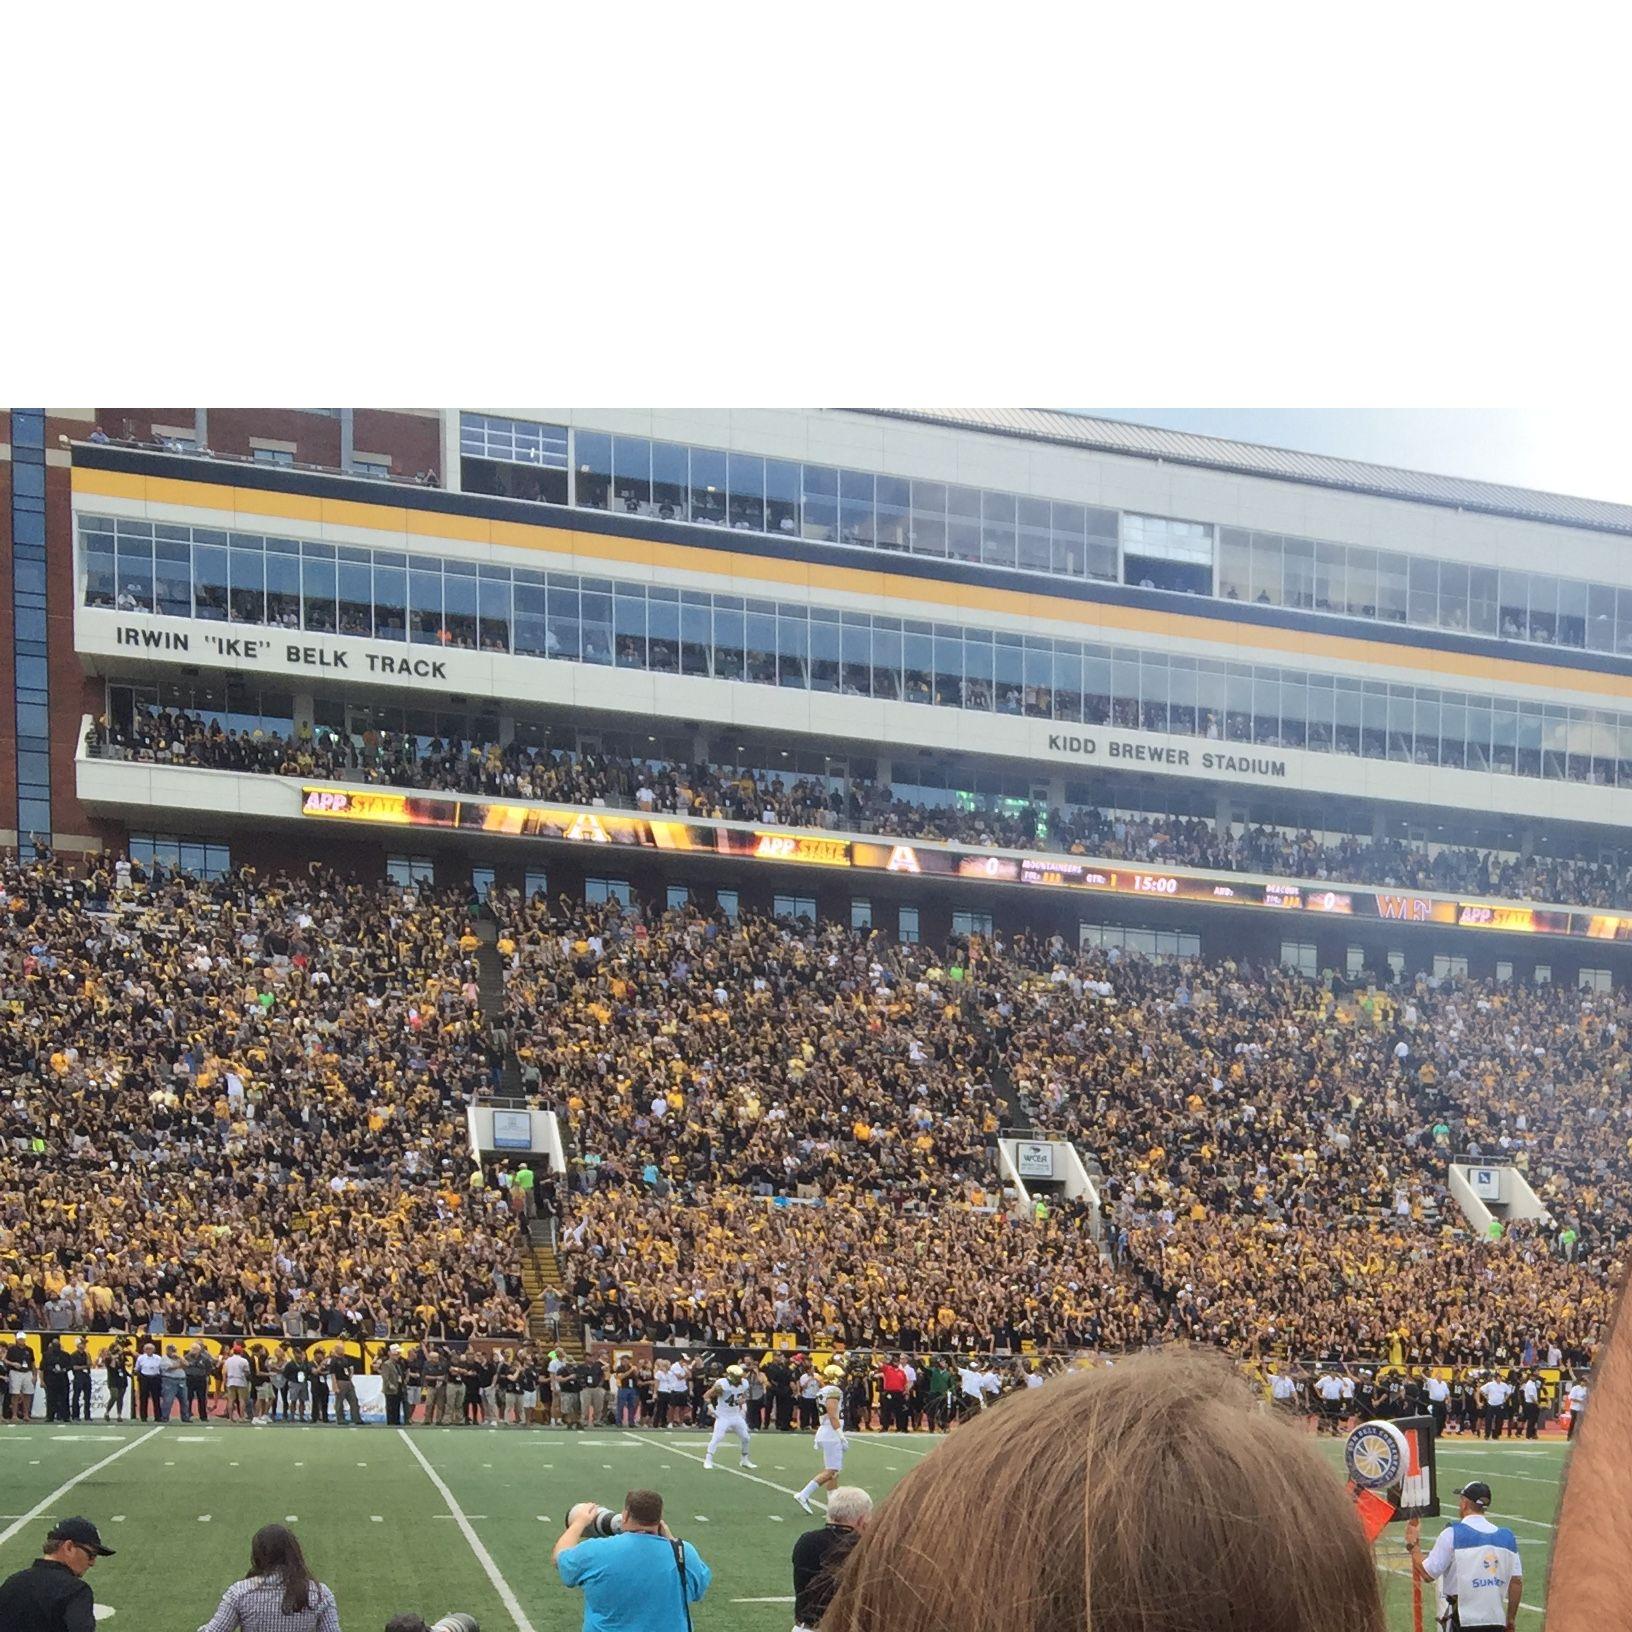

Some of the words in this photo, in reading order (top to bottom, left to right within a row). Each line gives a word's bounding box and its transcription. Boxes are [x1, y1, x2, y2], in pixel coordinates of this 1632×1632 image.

[117, 627, 189, 651] IRWIN
[204, 635, 271, 659] "IKE"
[286, 645, 348, 669] BELK
[365, 653, 446, 679] TRACK
[1048, 734, 1096, 754] KIDD
[1109, 741, 1189, 766] BREWER
[1202, 752, 1286, 777] STADIUM
[303, 791, 348, 811] APP
[759, 837, 795, 855] APP
[798, 840, 848, 861] STATE
[985, 857, 999, 875] 0
[1134, 875, 1177, 893] 15:00
[1323, 891, 1334, 910] 0
[1460, 906, 1491, 923] APP
